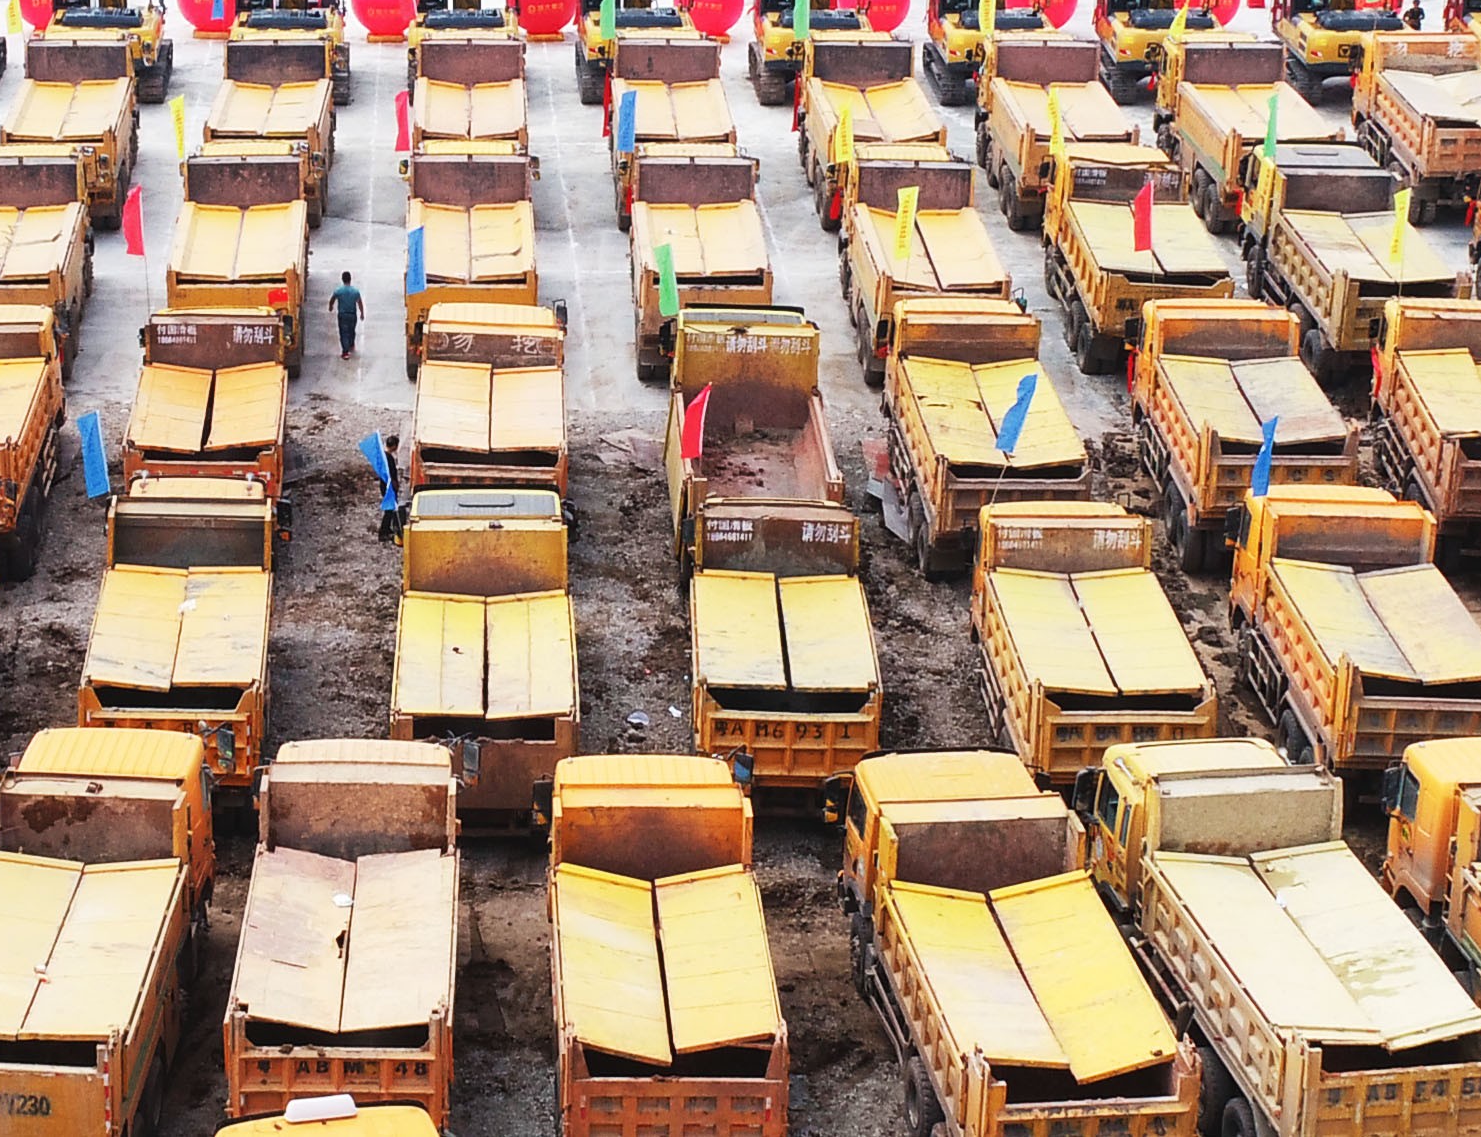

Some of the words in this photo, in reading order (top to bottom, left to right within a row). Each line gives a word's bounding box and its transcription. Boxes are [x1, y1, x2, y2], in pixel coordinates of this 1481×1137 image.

[802, 523, 851, 544] 请勿刮斗
[257, 1061, 428, 1075] 粤ABM48
